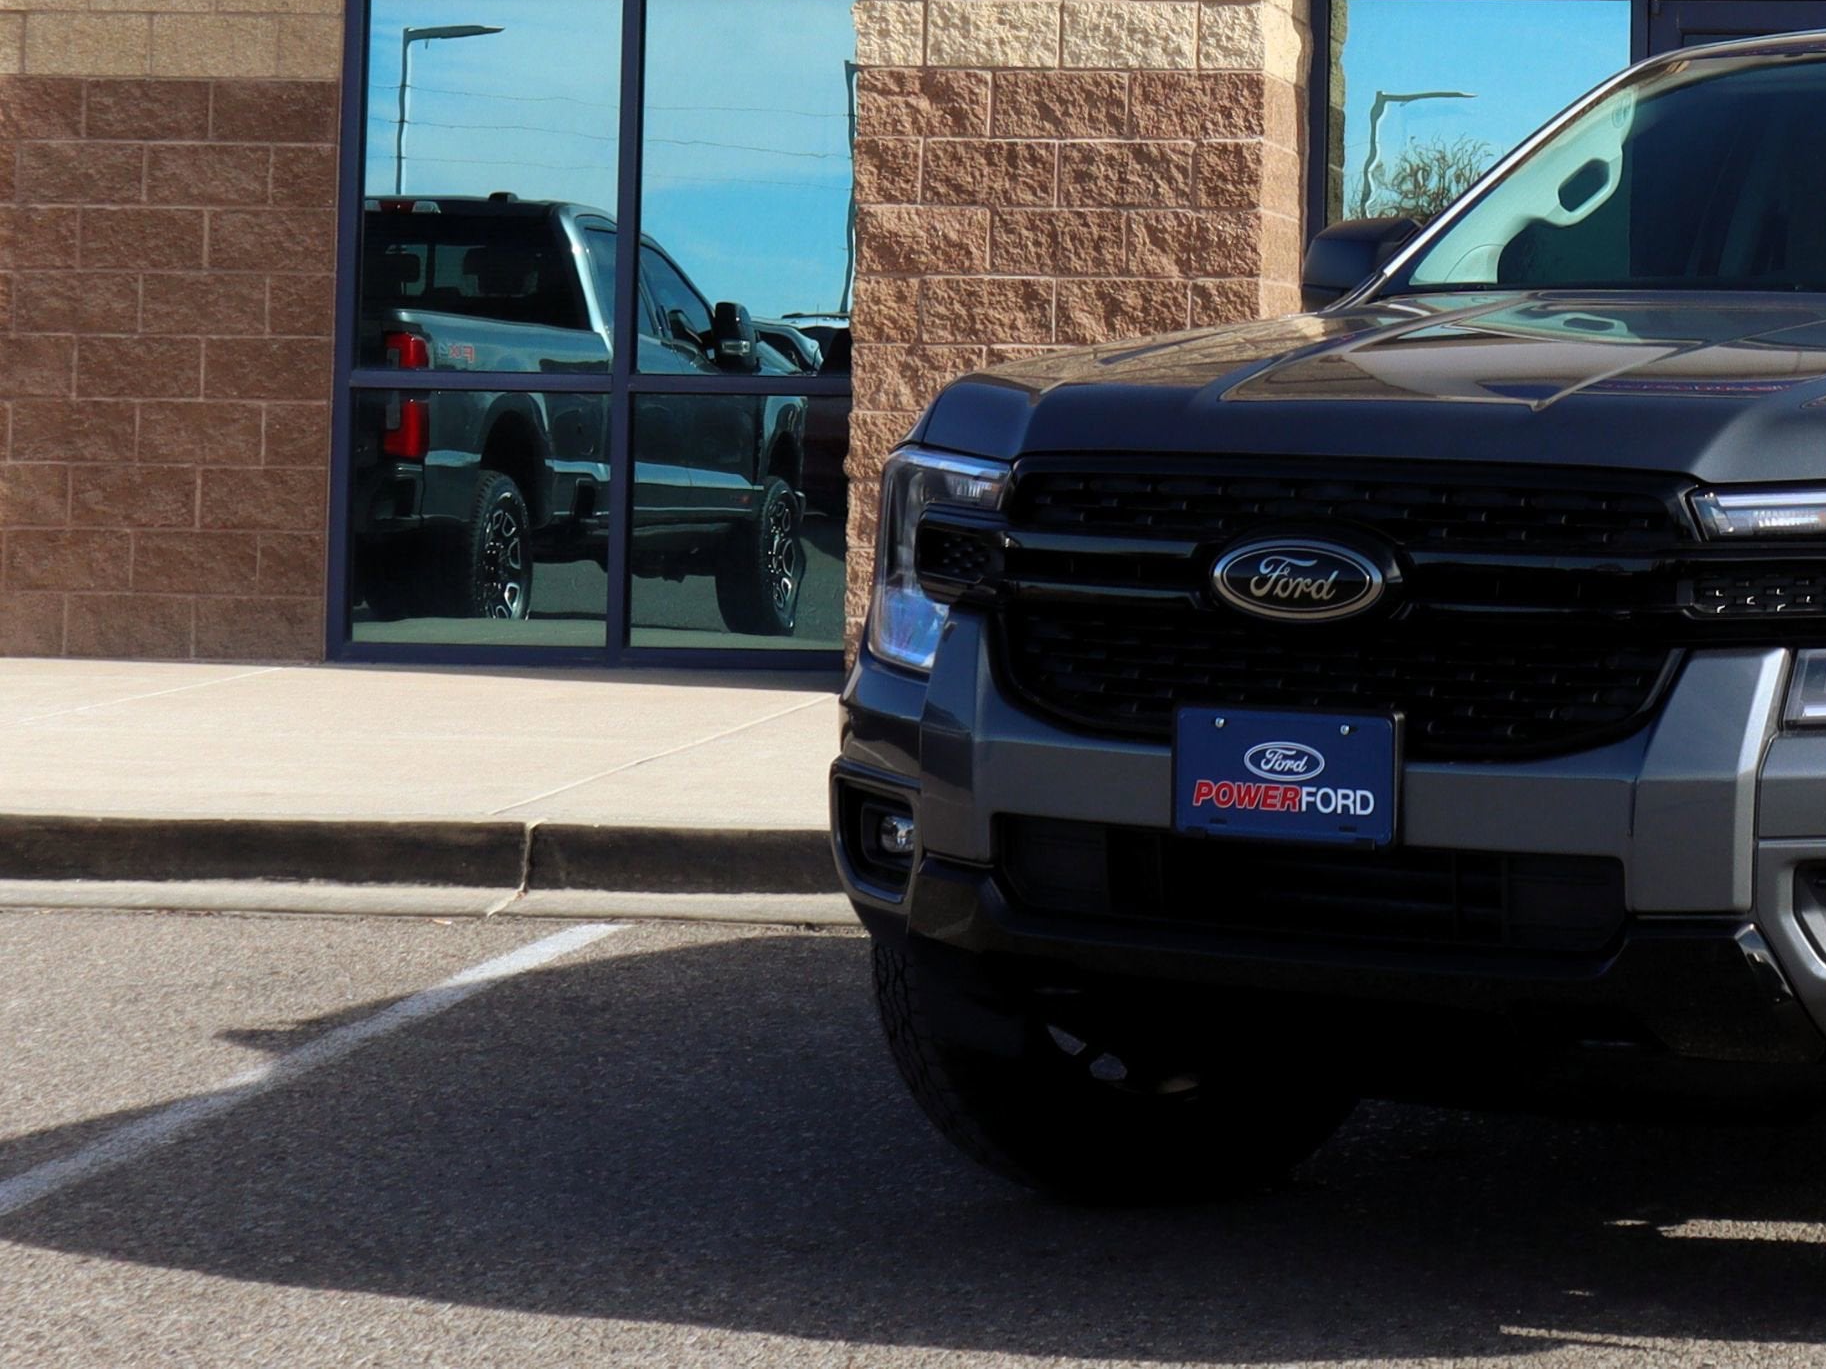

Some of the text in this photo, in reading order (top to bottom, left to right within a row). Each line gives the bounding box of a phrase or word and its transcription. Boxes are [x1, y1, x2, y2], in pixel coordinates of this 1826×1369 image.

[1250, 556, 1339, 601] Ford
[1260, 750, 1307, 773] Ford
[1193, 780, 1375, 816] POWERFORD
